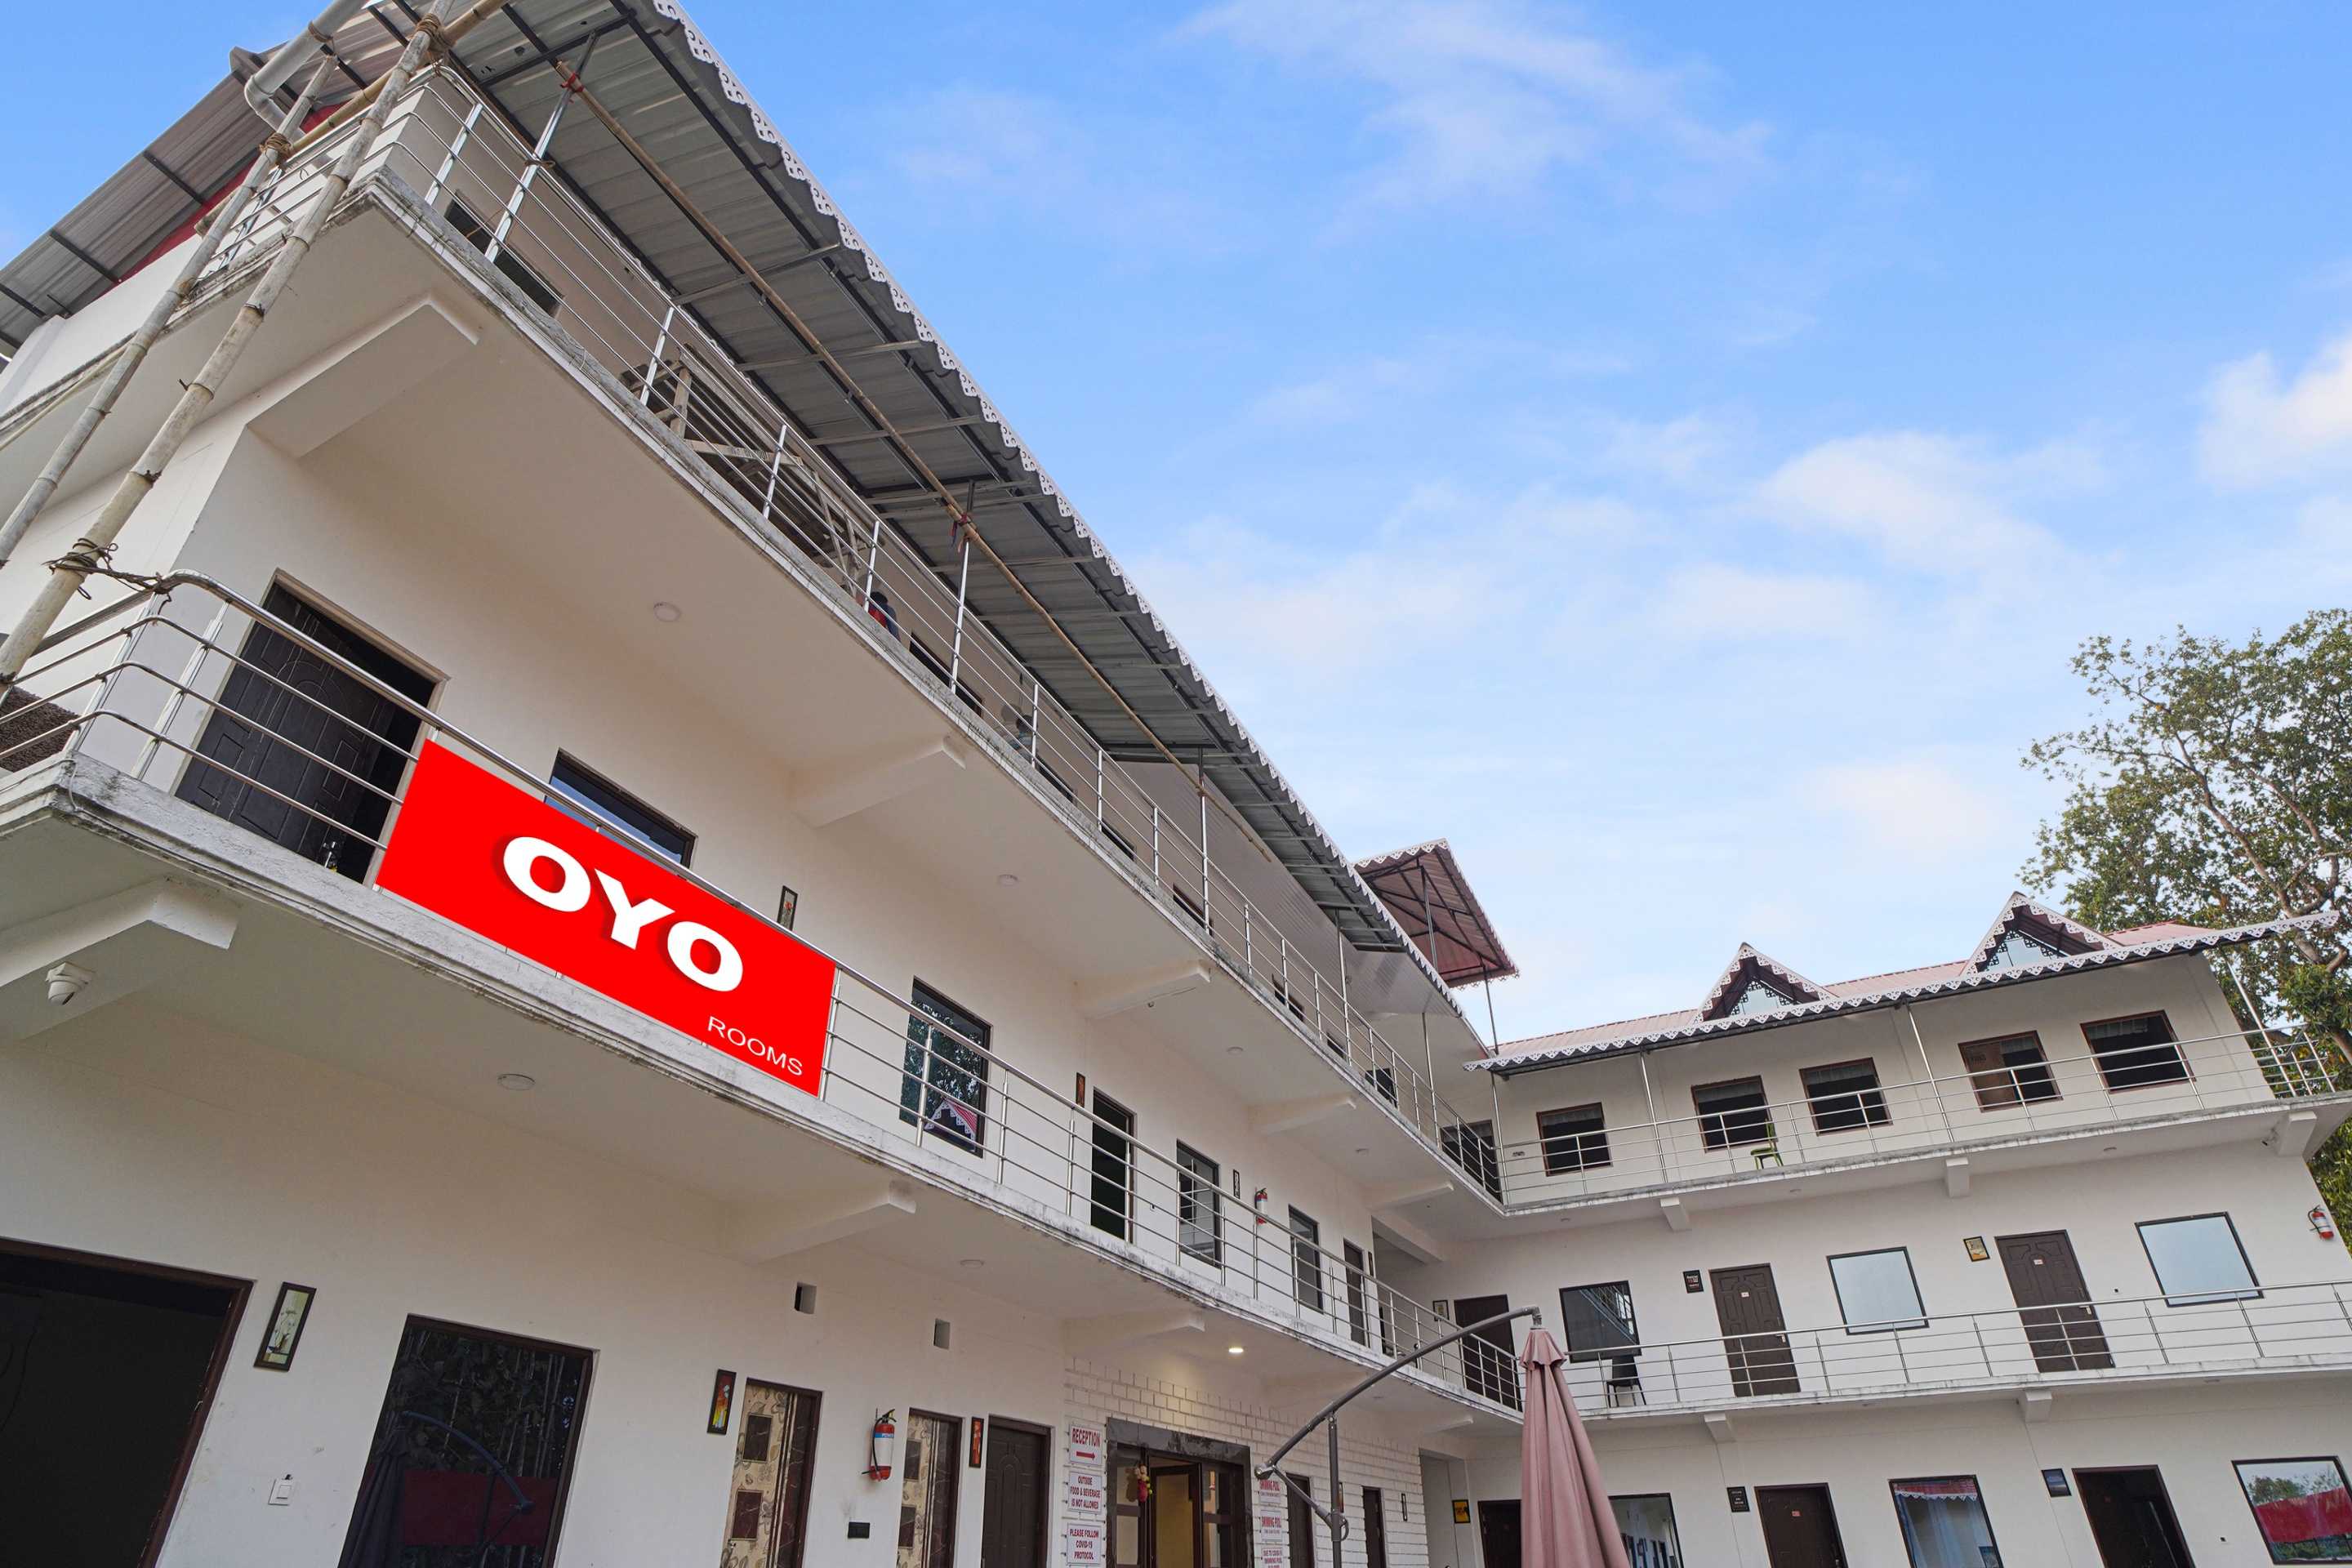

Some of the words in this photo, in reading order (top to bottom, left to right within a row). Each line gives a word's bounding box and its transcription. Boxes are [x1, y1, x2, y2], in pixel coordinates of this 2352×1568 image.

[502, 835, 743, 992] OYO
[706, 1015, 804, 1076] ROOMS
[1071, 1428, 1101, 1447] RECEPTION
[1078, 1476, 1093, 1486] OUTSIDE
[1071, 1486, 1080, 1495] FOOD
[1083, 1488, 1100, 1498] BEVERAGE
[1084, 1500, 1098, 1509] ALLOWED
[1070, 1529, 1084, 1537] PLEASE
[1085, 1530, 1098, 1538] FOLLOW
[1076, 1540, 1093, 1548] COVID-19
[1074, 1551, 1094, 1560] PROTOCOL
